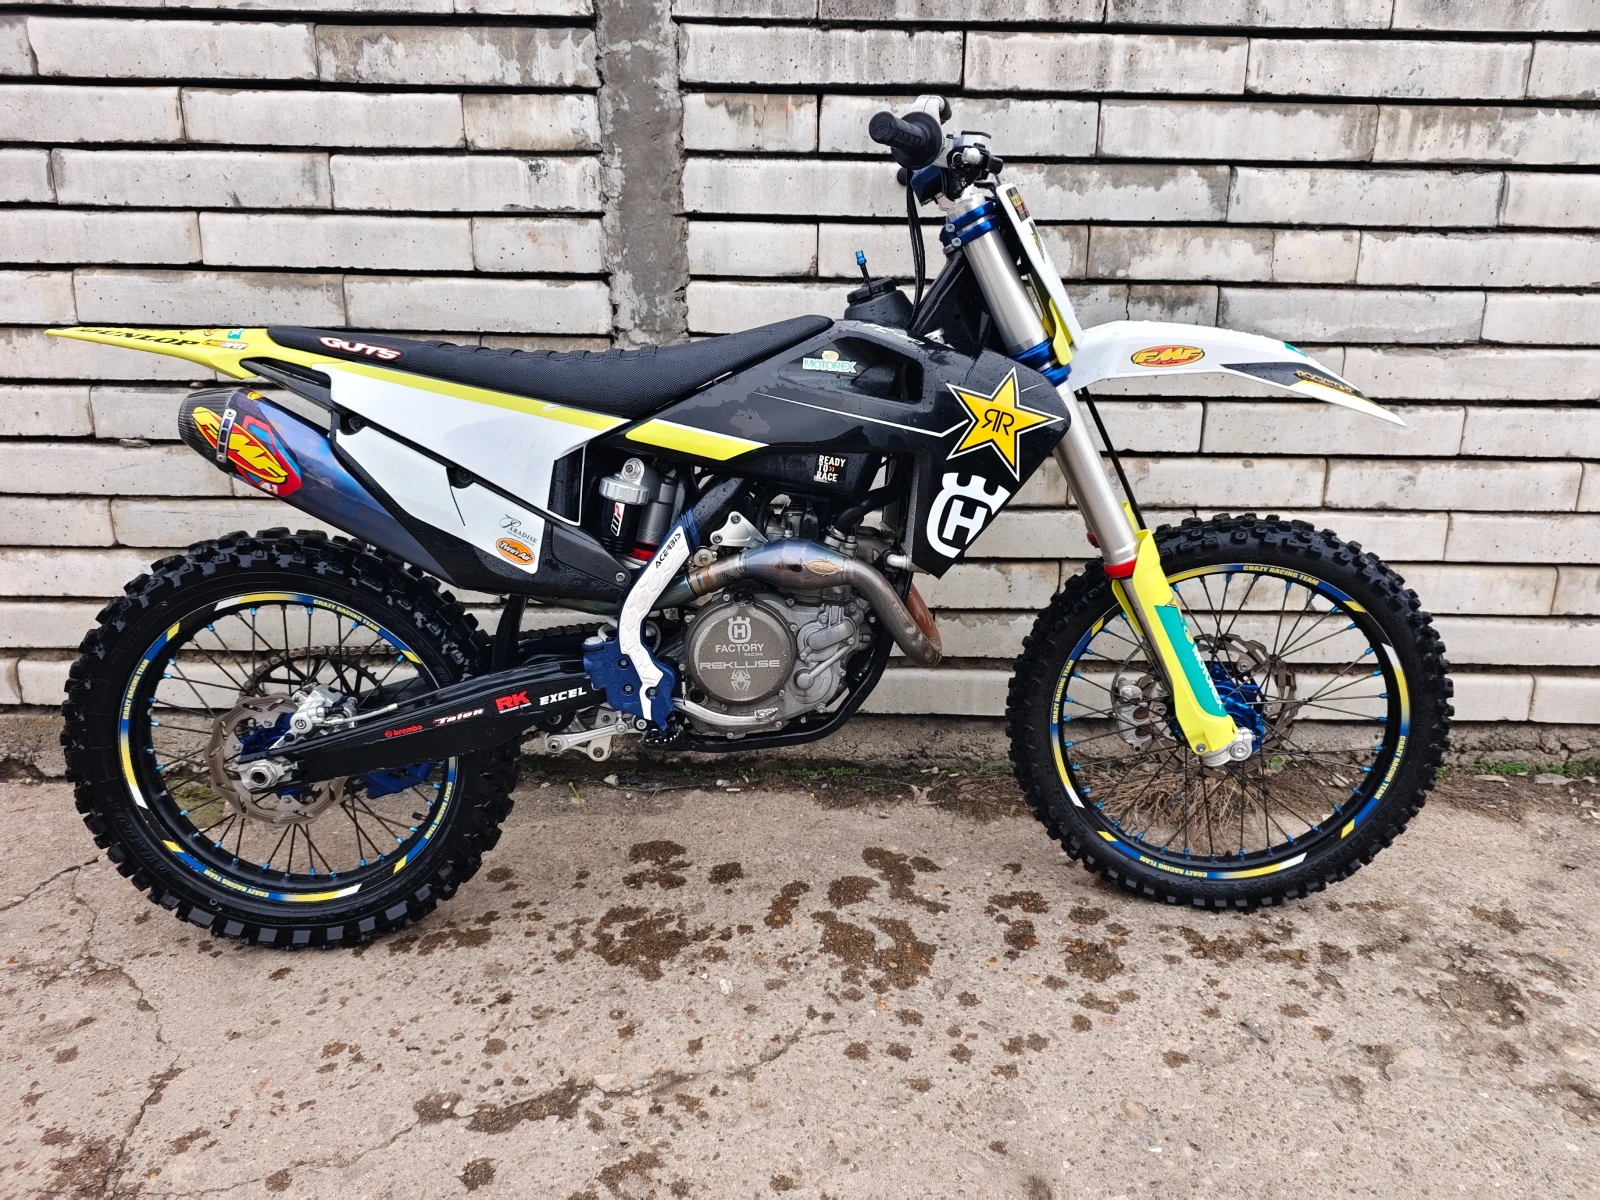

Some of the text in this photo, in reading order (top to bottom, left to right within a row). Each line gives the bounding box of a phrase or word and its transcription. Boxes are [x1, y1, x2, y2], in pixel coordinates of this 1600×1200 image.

[78, 327, 201, 346] DUNLOP
[319, 336, 401, 359] GUTS
[1133, 346, 1203, 364] FMF
[803, 358, 855, 372] MOTOREX
[192, 408, 289, 481] FMF
[819, 454, 846, 468] READY
[819, 464, 828, 473] TO
[816, 470, 838, 482] RACE
[499, 513, 538, 543] PARADISE
[499, 541, 533, 562] Twin Air
[655, 532, 682, 569] ACERBIS
[1269, 567, 1299, 578] RACING
[1299, 574, 1320, 586] TEAM
[314, 600, 380, 632] CRAZY RACING TEAM
[715, 643, 765, 653] FACTORY
[700, 659, 780, 670] REKLUSE
[123, 659, 149, 719] CRAZY RACING TEAM
[539, 687, 587, 706] EXCEL
[1052, 659, 1075, 724] CRAZY RACING TEAM
[495, 690, 530, 711] RK
[435, 708, 484, 724] Talon
[393, 724, 423, 736] brembo
[1374, 736, 1405, 799] CRAZY RACING TEAM
[424, 782, 452, 840] CRAZY RACING TEAM
[1140, 856, 1158, 867] TEAM
[1159, 863, 1184, 874] RACING
[204, 869, 269, 897] CRAZY RACING TEAM
